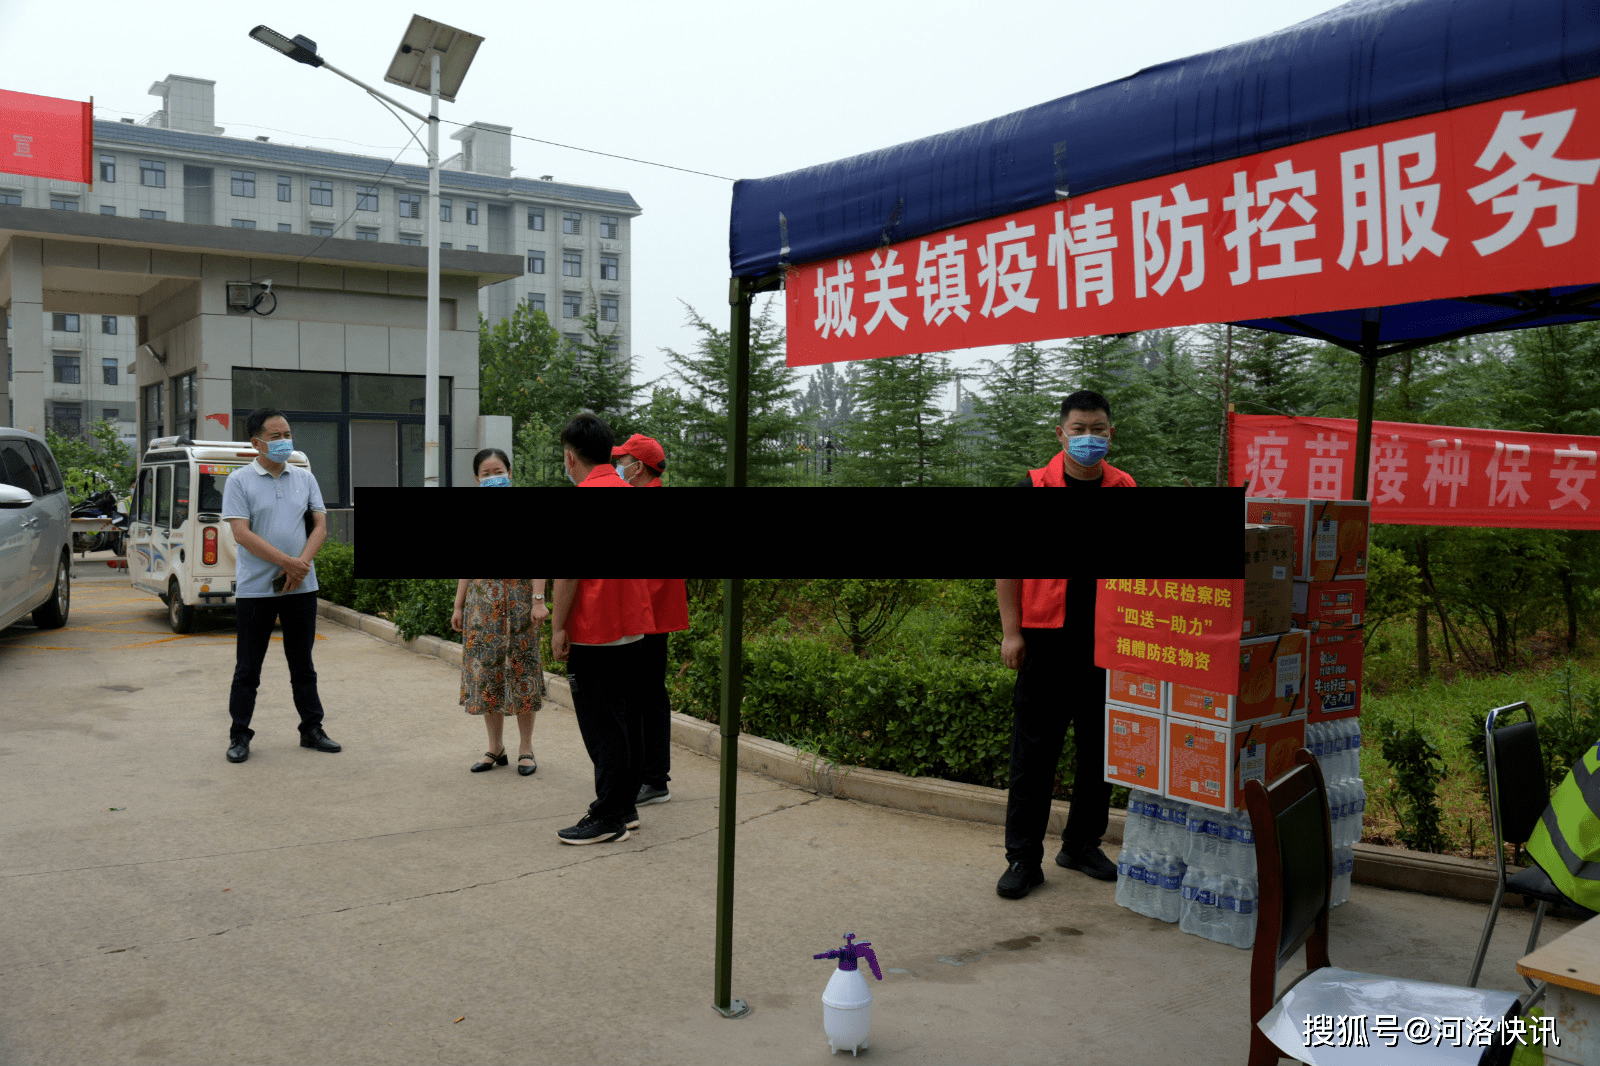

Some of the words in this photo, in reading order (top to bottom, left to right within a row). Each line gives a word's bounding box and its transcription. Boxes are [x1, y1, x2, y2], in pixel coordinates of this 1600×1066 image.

[13, 134, 33, 158] 宣
[813, 108, 1600, 340] 城关镇疫情防控服务
[1245, 430, 1597, 510] 疫苗接种保安
[1105, 579, 1231, 608] 汝阳县人民检察院
[1117, 637, 1211, 671] 捐赠防疫物资
